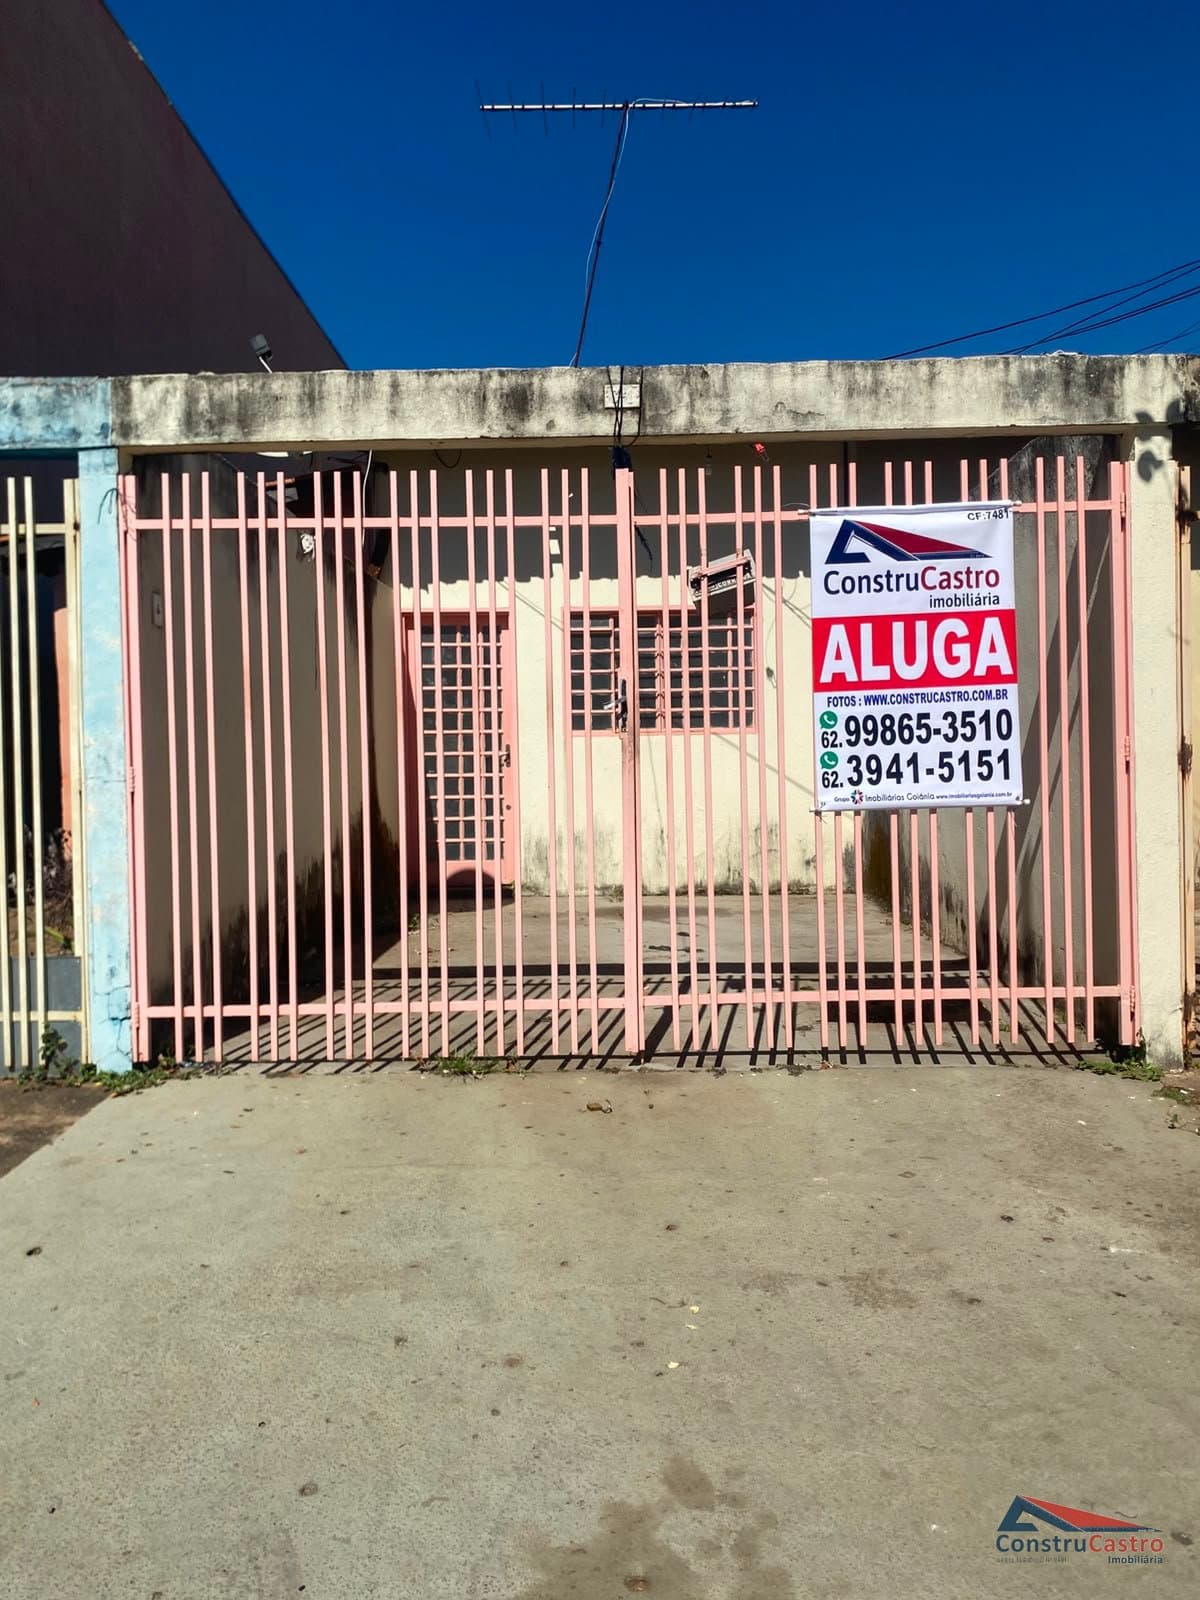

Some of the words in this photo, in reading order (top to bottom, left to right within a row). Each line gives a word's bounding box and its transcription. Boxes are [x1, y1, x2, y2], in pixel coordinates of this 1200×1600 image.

[967, 507, 1009, 521] CF:7481
[823, 566, 1000, 595] ConstruCastro
[929, 592, 1000, 609] imobiliária
[819, 616, 1014, 683] ALUGA
[827, 695, 857, 708] FOTOS
[863, 688, 1009, 707] WWW.CONSTRUCASTRO.COM.BR
[844, 708, 1013, 748] 99865-3510
[846, 748, 1011, 787] 3941-5151
[906, 792, 935, 801] Goiânia
